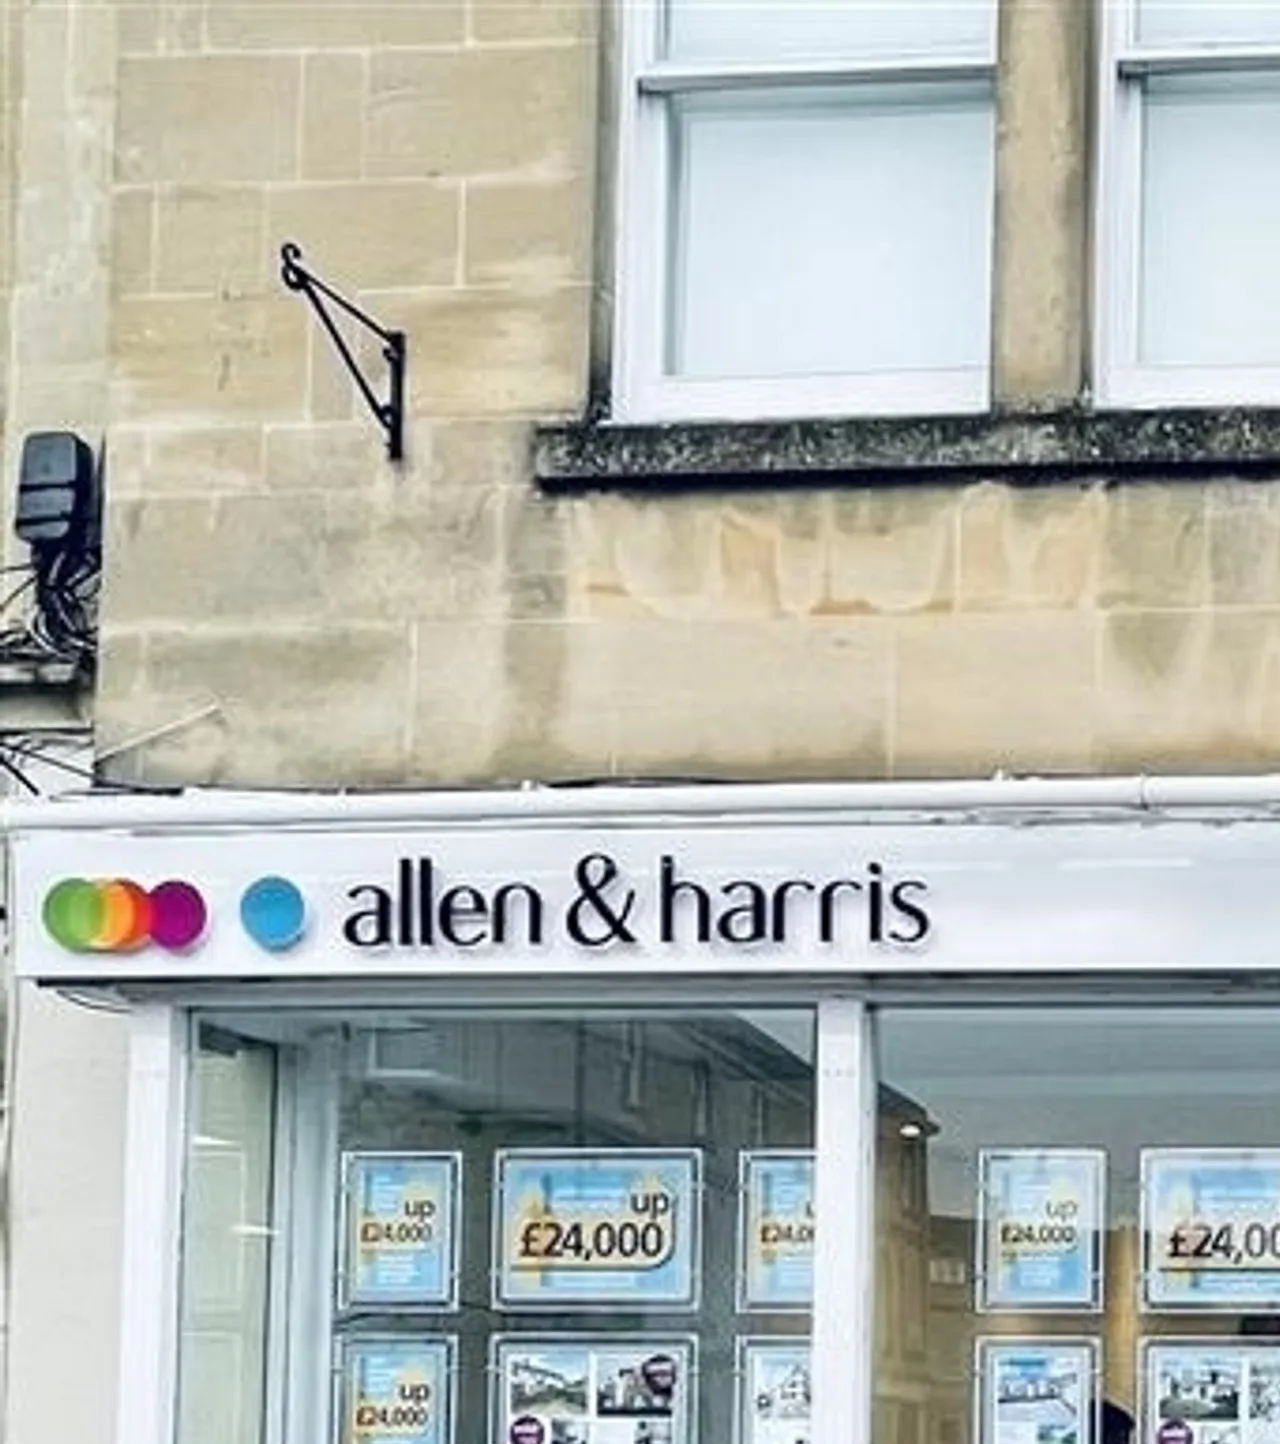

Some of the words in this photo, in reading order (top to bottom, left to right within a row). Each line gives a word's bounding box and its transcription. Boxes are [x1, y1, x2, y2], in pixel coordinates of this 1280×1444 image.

[343, 857, 542, 947] allen
[566, 853, 638, 946] &
[660, 855, 930, 944] harris
[404, 1200, 436, 1222] up
[631, 1192, 670, 1218] up
[1046, 1201, 1078, 1221] up
[520, 1222, 663, 1261] £24,000
[400, 1385, 429, 1405] up
